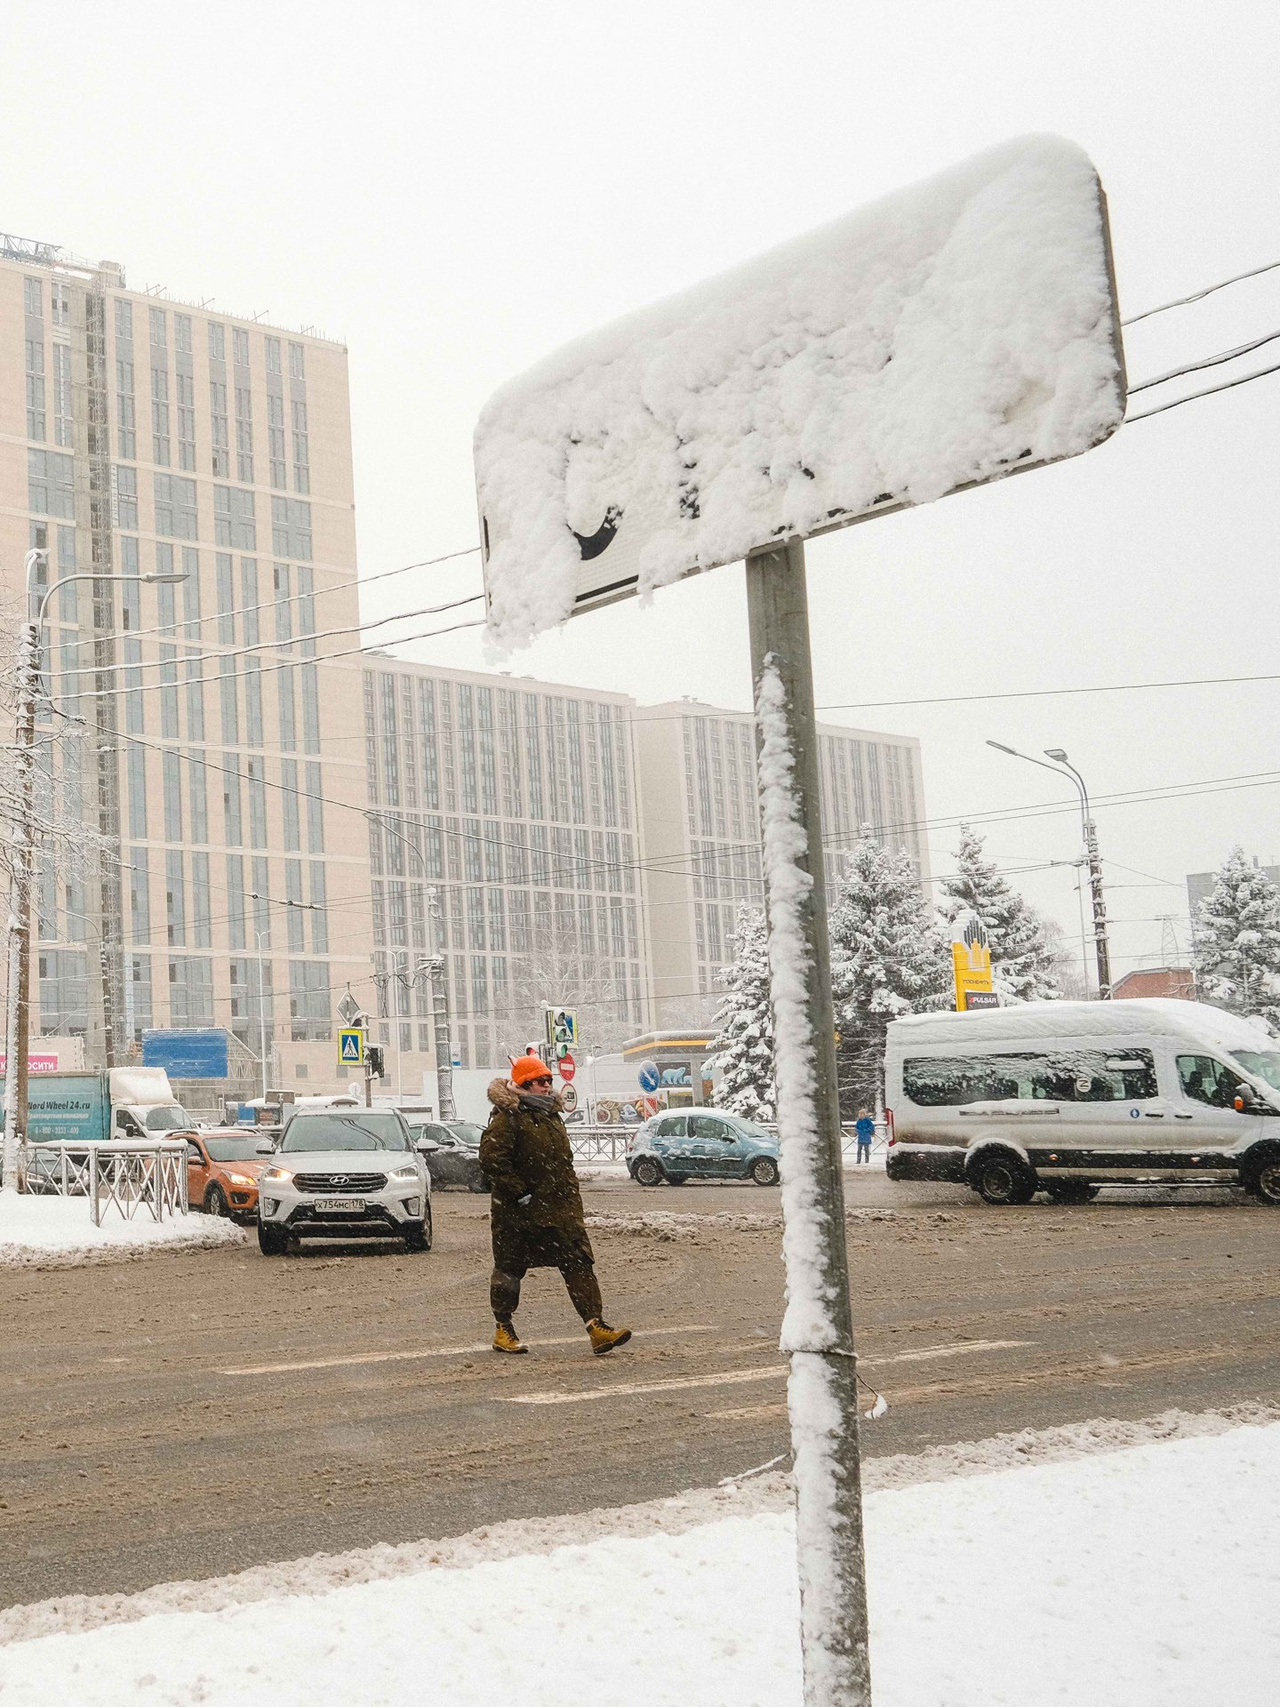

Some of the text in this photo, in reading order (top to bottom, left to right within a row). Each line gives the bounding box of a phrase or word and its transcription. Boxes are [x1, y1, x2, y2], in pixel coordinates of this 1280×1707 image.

[27, 1062, 54, 1070] ОСИТИ
[46, 1100, 69, 1110] Wheel
[70, 1100, 91, 1110] 24.ru
